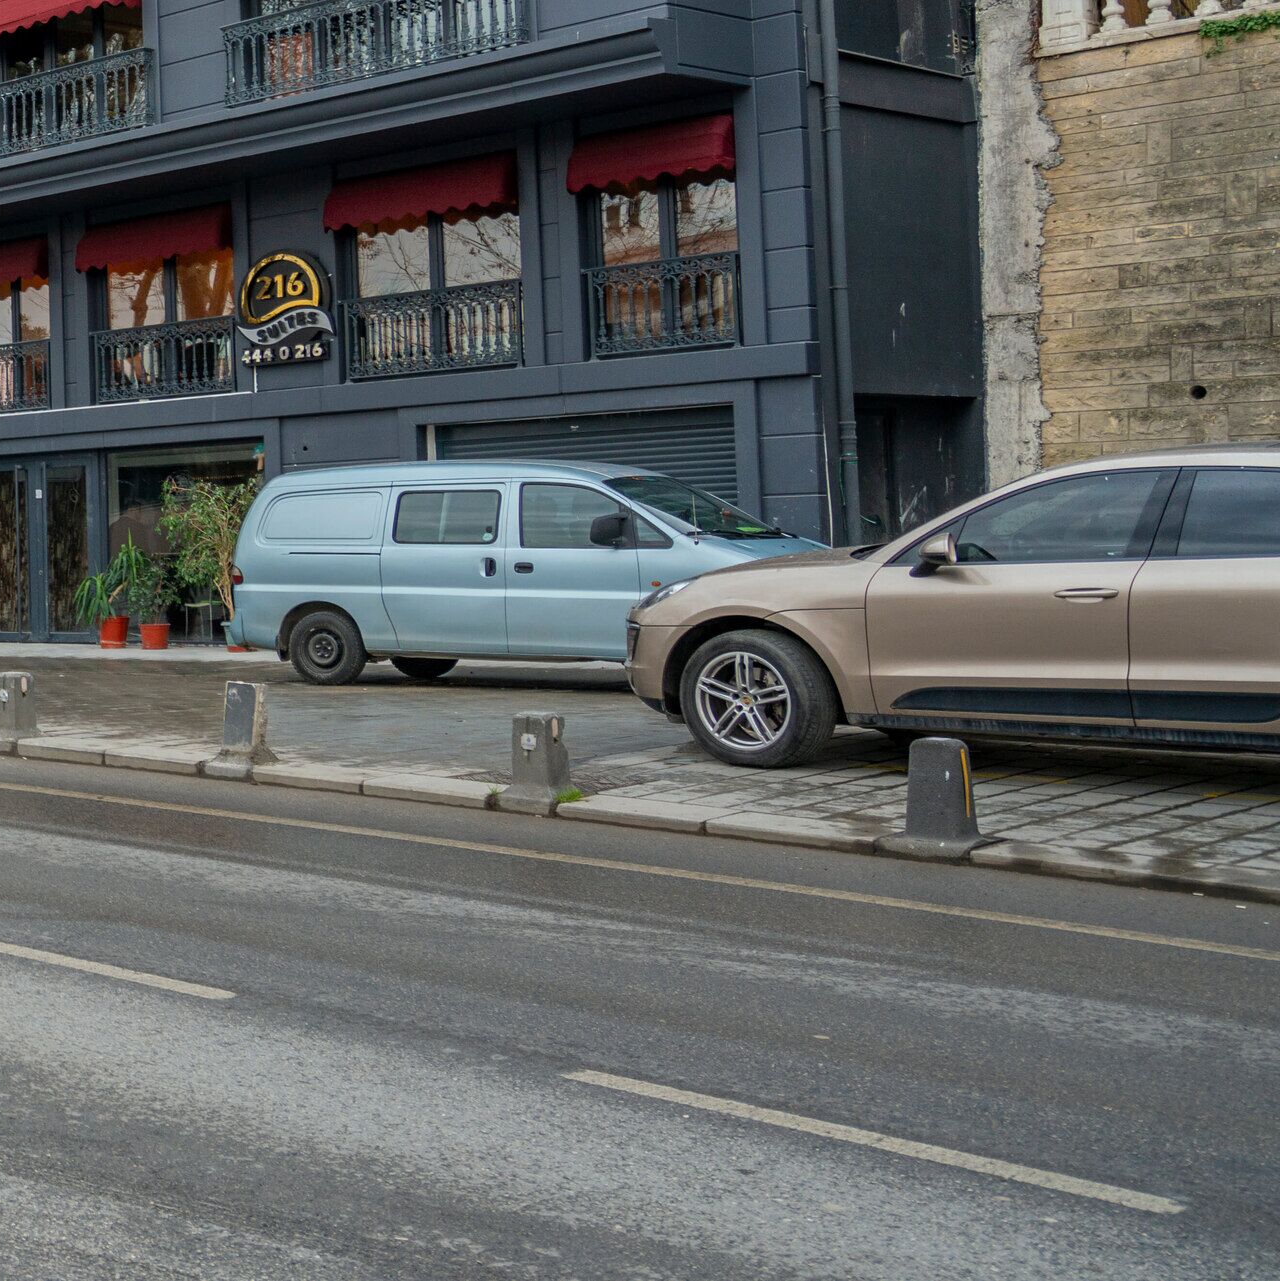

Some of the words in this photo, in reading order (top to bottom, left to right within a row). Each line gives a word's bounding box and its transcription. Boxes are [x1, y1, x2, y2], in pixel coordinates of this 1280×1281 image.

[255, 272, 305, 300] 216
[256, 311, 320, 343] SUITES
[241, 348, 273, 364] 444
[279, 346, 290, 360] 0
[294, 342, 323, 359] 216
